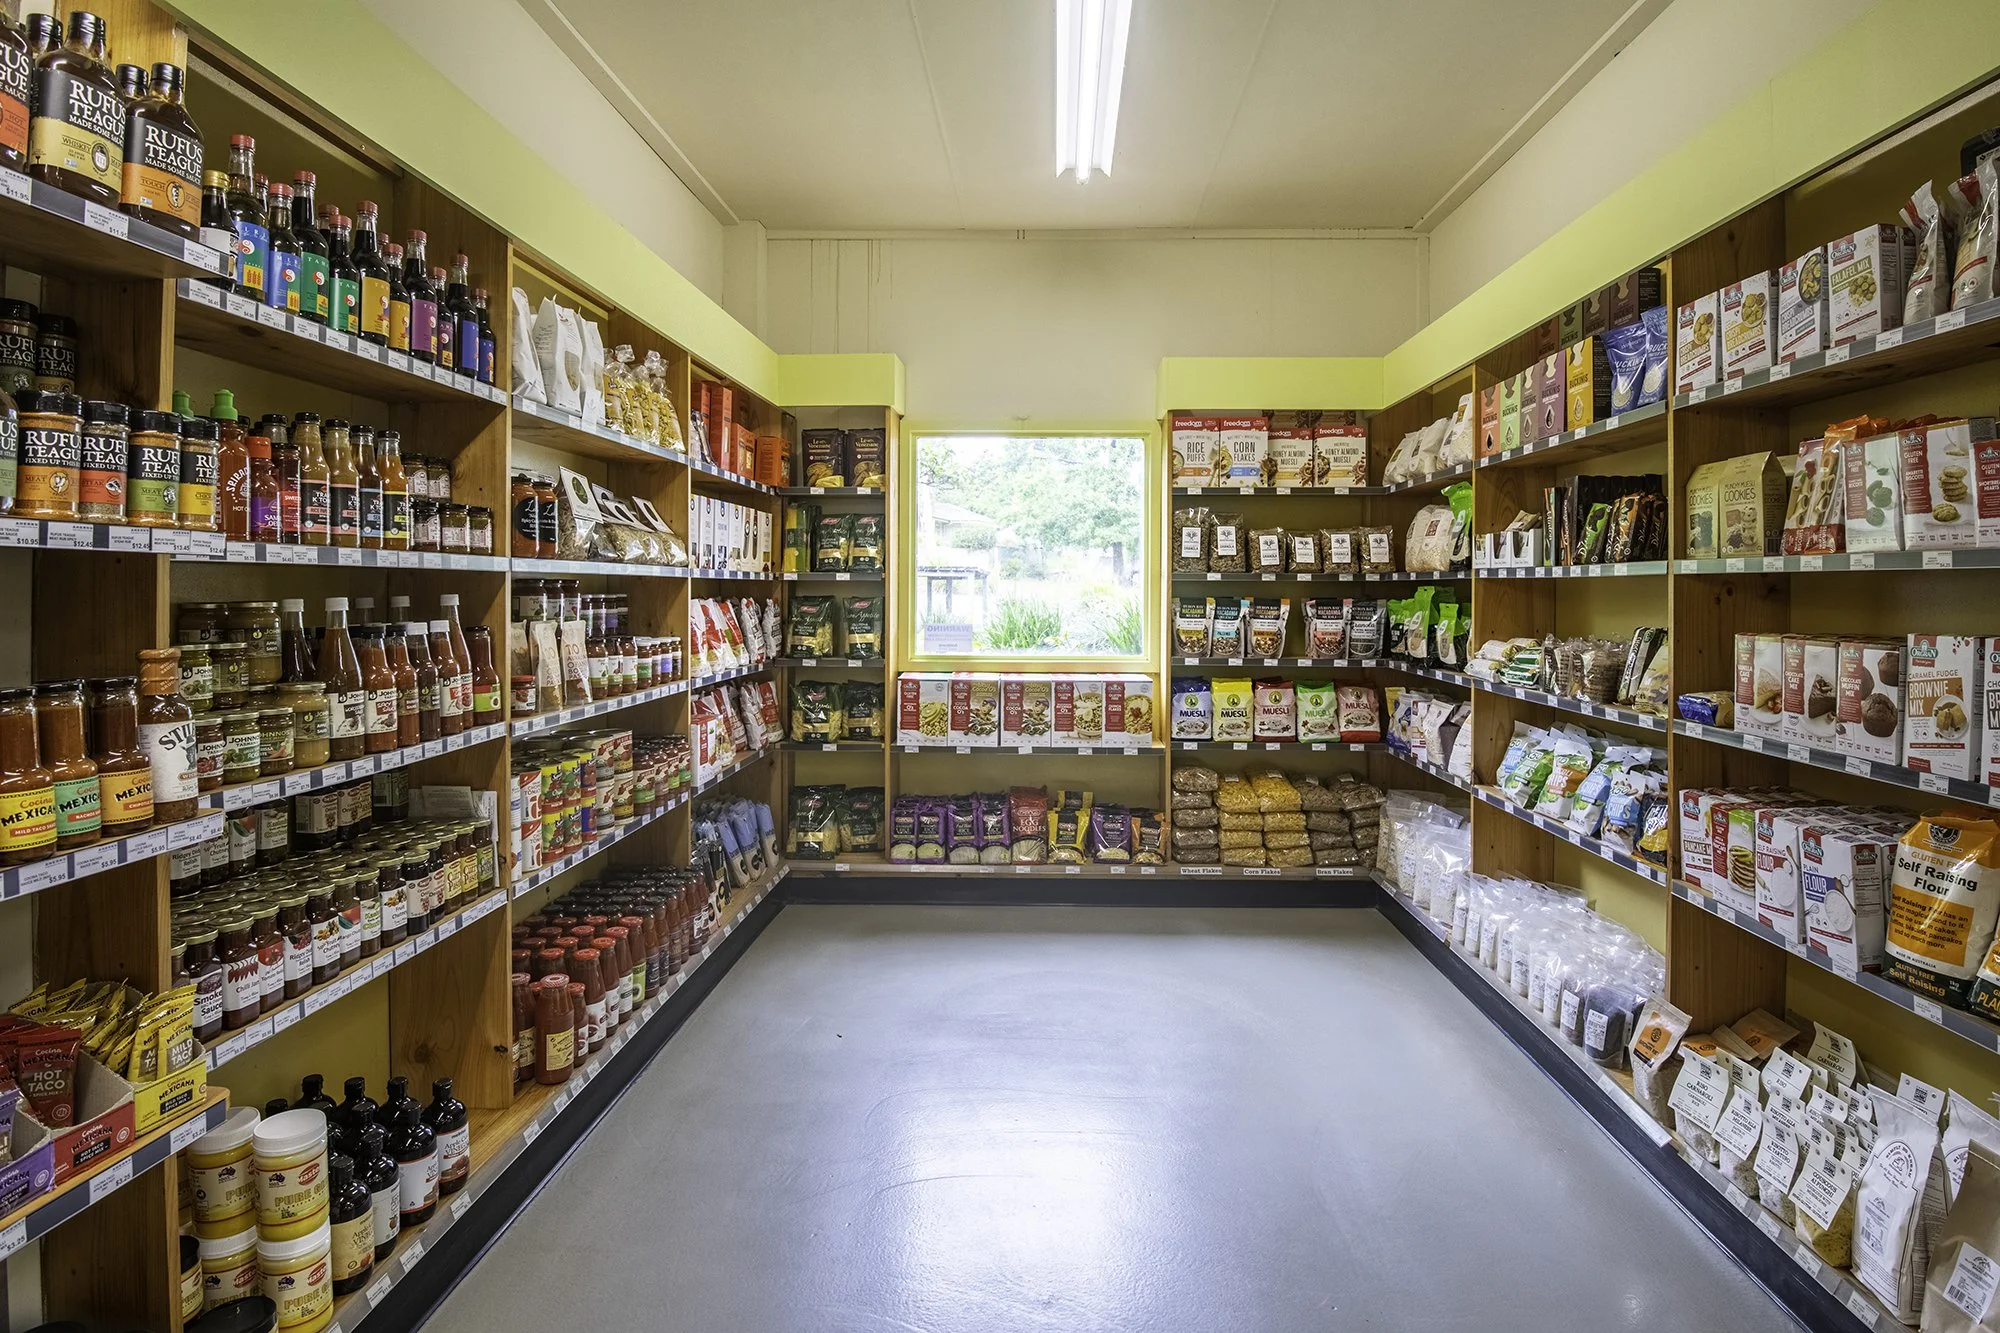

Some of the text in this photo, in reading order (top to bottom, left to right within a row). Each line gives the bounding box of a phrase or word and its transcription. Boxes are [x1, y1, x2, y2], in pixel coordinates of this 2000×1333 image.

[69, 79, 126, 124] RUFUS
[69, 99, 125, 140] TEAGUE
[69, 115, 92, 129] MADE
[93, 125, 111, 139] SOME
[145, 125, 203, 163] RUFUS
[145, 143, 202, 178] TEAGUE
[145, 157, 166, 170] MADE
[167, 165, 186, 177] SOME
[1831, 258, 1871, 285] FALAFEL MIX
[1187, 442, 1205, 453] RICE
[1233, 441, 1256, 453] CORN
[1187, 454, 1206, 462] PUFFS
[1233, 453, 1256, 462] FLAKES
[1281, 458, 1298, 466] MUESLI
[1333, 456, 1351, 464] MUESLI
[1904, 451, 1923, 459] GLUTEN
[1689, 493, 1713, 506] COOKIES
[1724, 488, 1756, 503] COOKIES
[1911, 648, 1937, 658] ORGRAN
[1909, 681, 1949, 698] BROWNIE
[1910, 700, 1924, 715] MIX
[151, 845, 166, 854] $5.95
[101, 859, 117, 868] $5.95
[1758, 852, 1773, 870] FLOUR
[1911, 851, 1944, 866] GLUTEN
[1803, 864, 1819, 873] PLAIN
[1898, 857, 1978, 891] Self Raising
[49, 874, 66, 883] $5.95
[1805, 874, 1827, 893] FLOUR
[1914, 877, 1949, 896] Flour
[1902, 897, 1927, 910] Raising
[1928, 932, 1963, 945] pancakes
[1912, 957, 1937, 968] AUSTRALIA
[1895, 961, 1935, 981] GLUTEN FREE
[1889, 967, 1946, 996] Self Raising
[35, 1048, 62, 1056] Cocina
[171, 1039, 193, 1057] MILD
[33, 1070, 62, 1081] HOT
[28, 1080, 65, 1093] TACO
[159, 1079, 195, 1101] MEXICANA
[1686, 1082, 1713, 1101] CARNAROLI
[1696, 1080, 1708, 1090] RISO
[1731, 1109, 1749, 1123] RISOTTO
[81, 1124, 103, 1137] Cocina
[71, 1126, 113, 1153] MEXICANA
[1812, 1172, 1837, 1193] COUSCOUS
[1817, 1181, 1834, 1198] FUNGHI
[7, 1236, 26, 1252] $3.25
